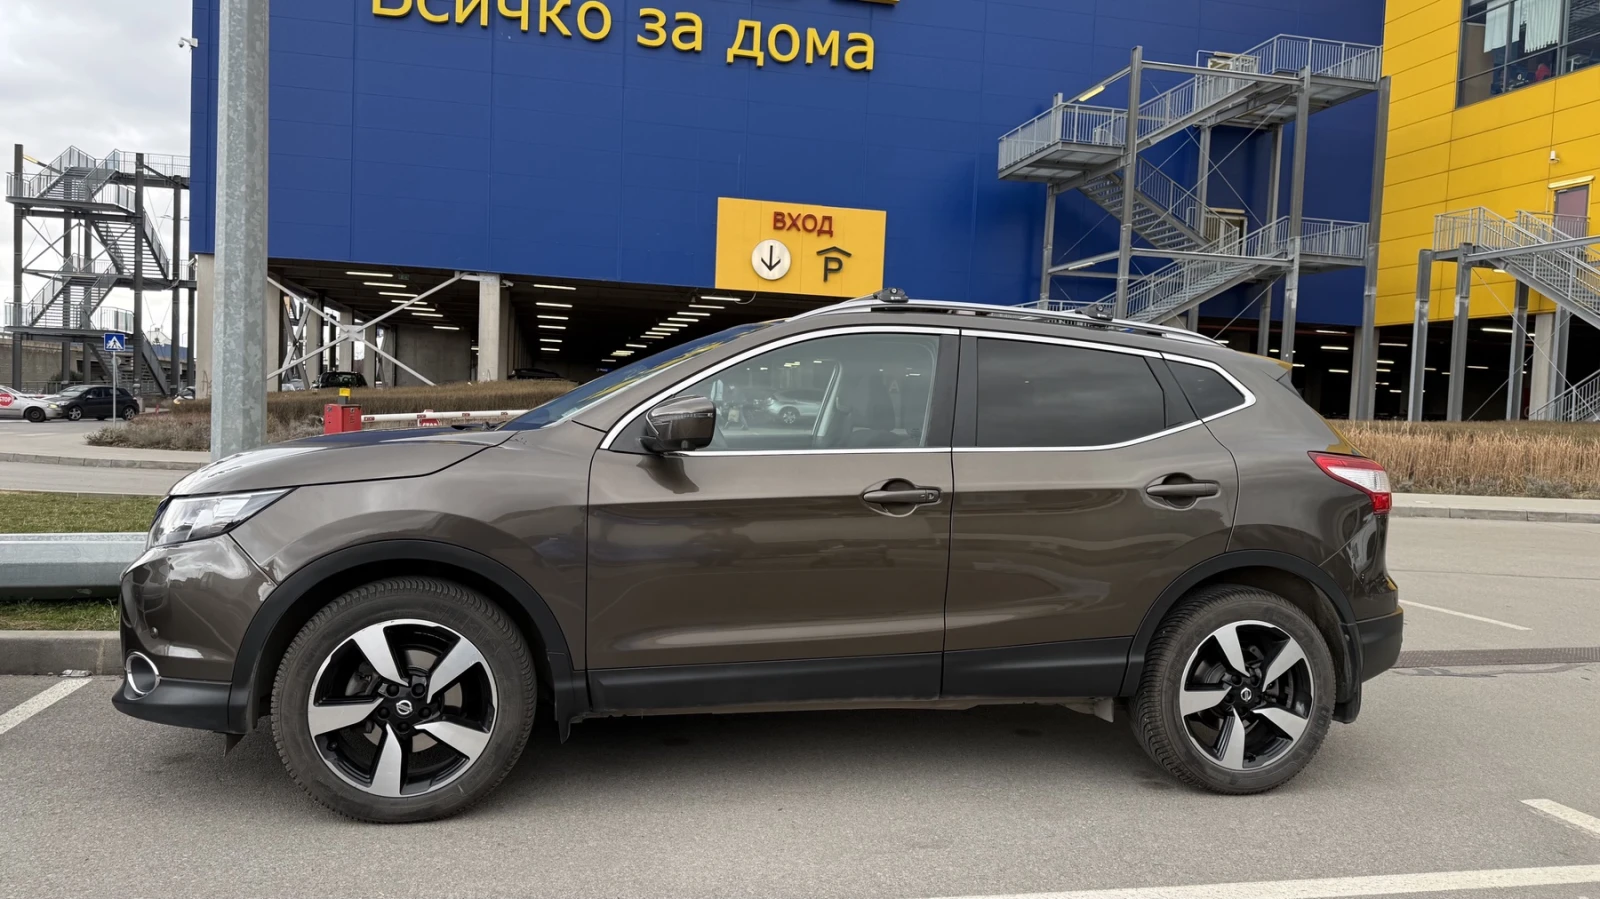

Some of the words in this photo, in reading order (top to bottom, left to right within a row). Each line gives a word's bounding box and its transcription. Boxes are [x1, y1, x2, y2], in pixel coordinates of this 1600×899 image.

[636, 7, 704, 52] за
[726, 18, 875, 71] дома
[773, 211, 834, 238] ВХОД
[823, 256, 843, 283] P
